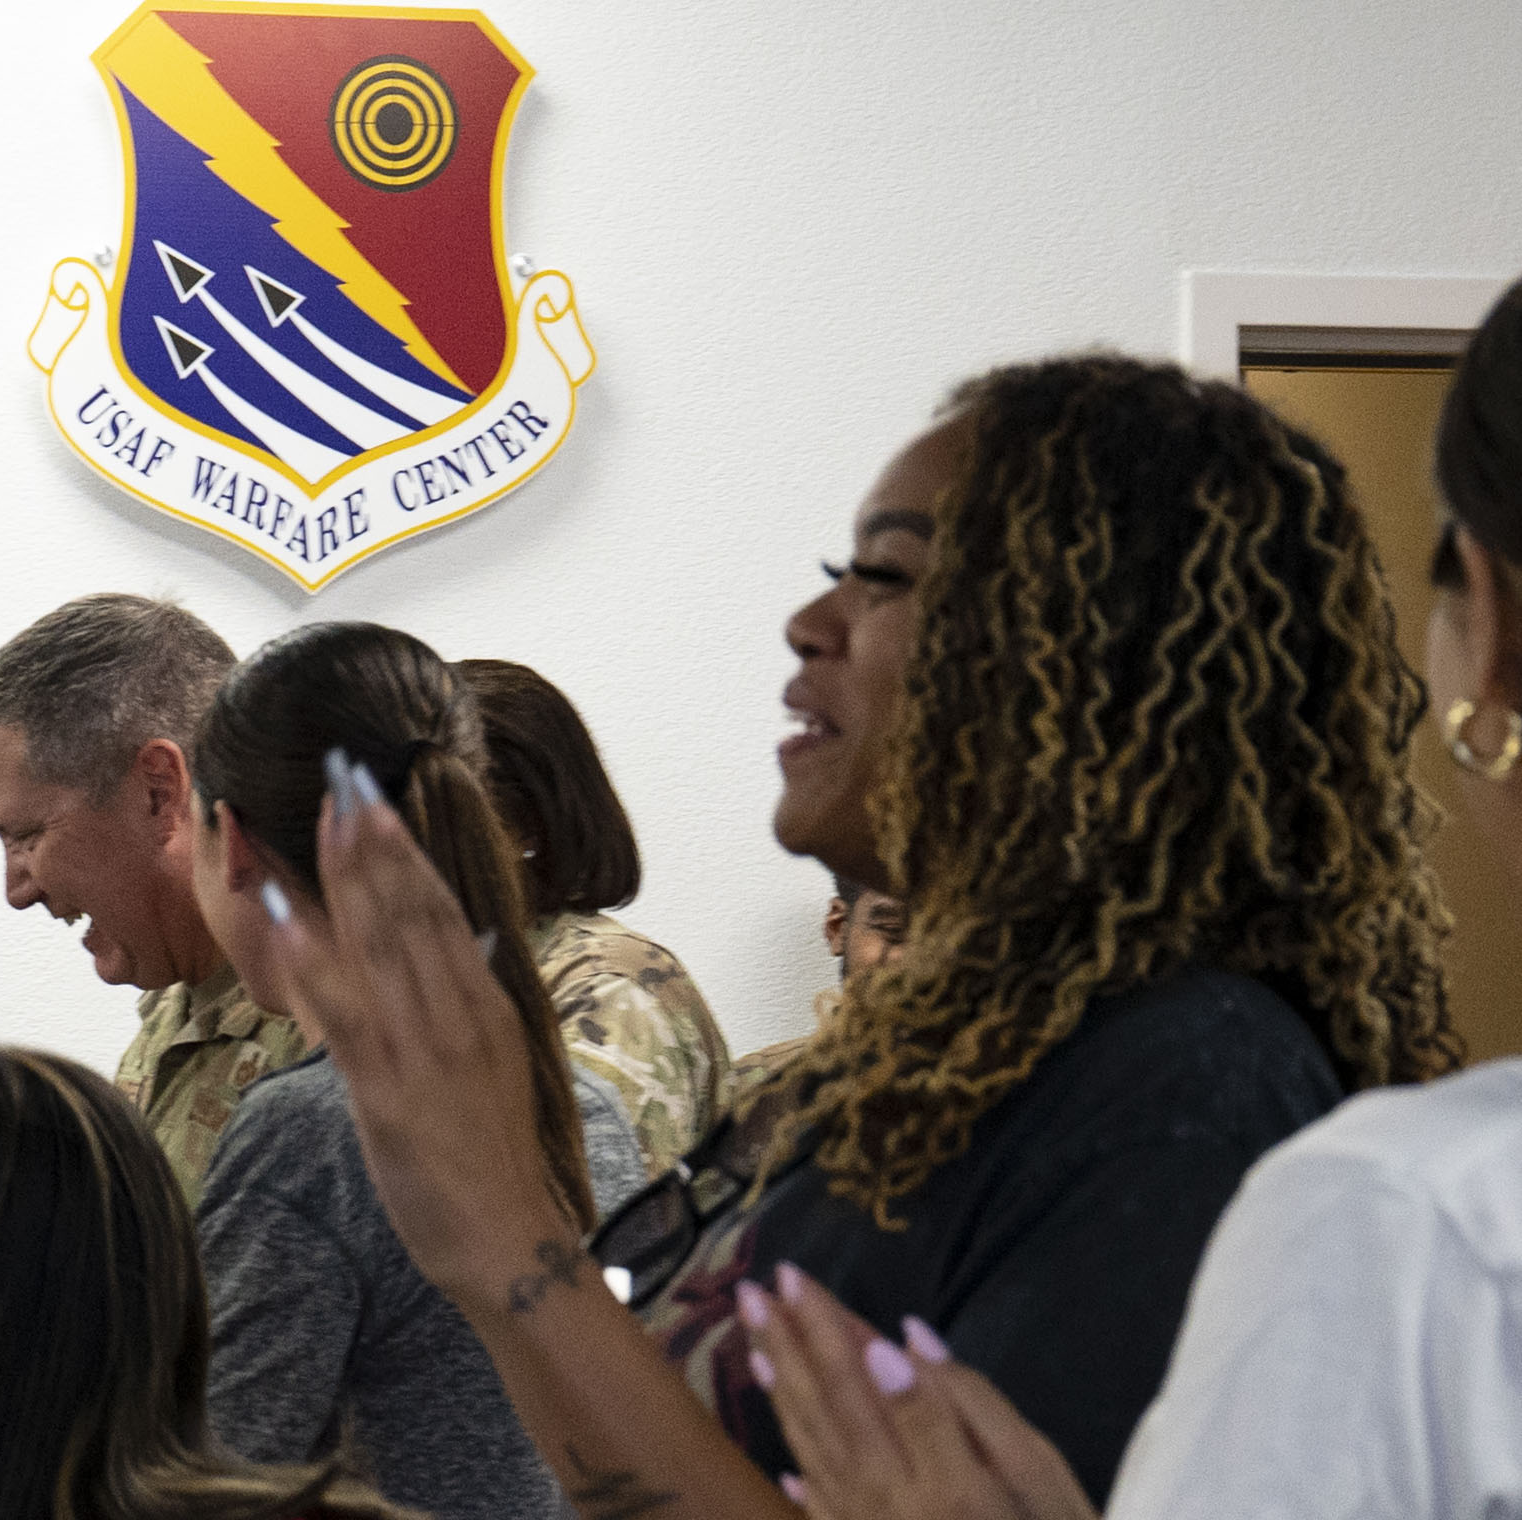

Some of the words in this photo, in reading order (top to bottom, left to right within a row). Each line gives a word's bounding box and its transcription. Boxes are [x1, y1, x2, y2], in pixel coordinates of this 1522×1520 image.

[75, 385, 176, 478] USAF
[191, 455, 372, 564] WARFARE
[391, 399, 551, 513] CENTER
